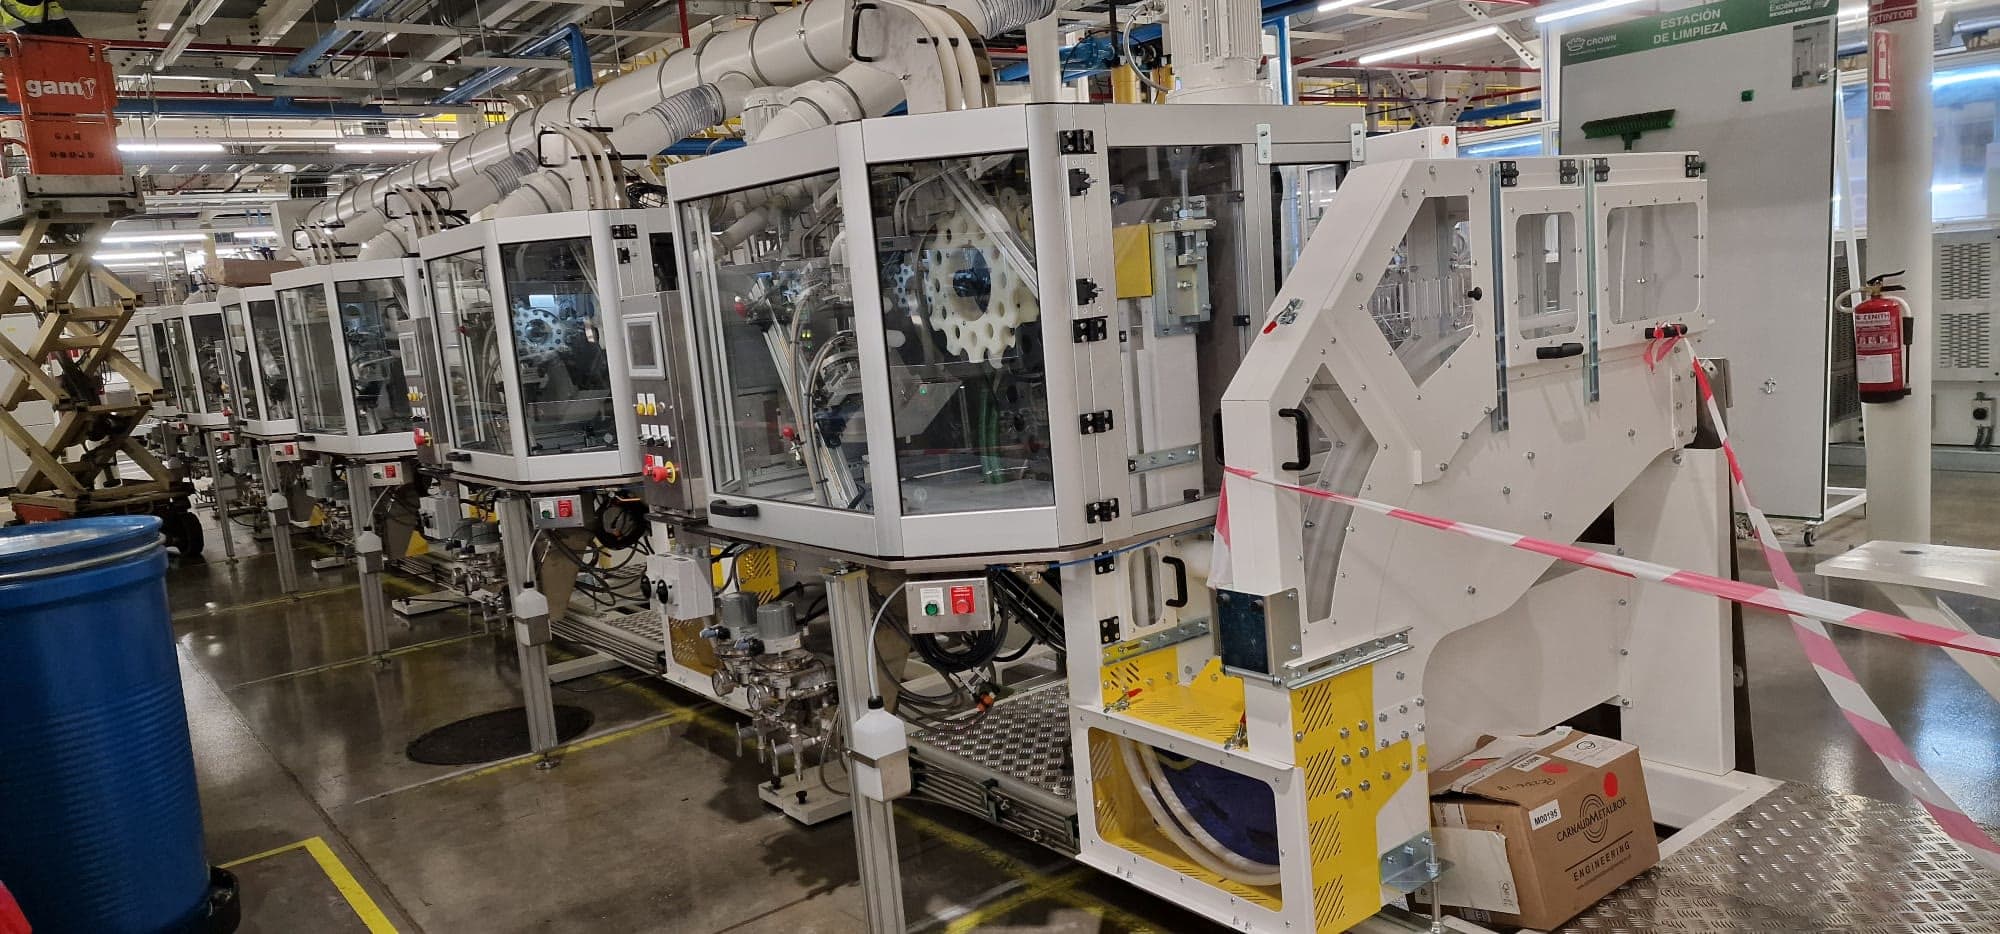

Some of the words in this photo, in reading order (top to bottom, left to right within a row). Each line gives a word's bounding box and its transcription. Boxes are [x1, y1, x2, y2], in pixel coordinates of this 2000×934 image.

[1661, 8, 1721, 29] ESTACIÓN
[1586, 34, 1617, 46] CROWN
[1653, 32, 1670, 45] DE
[1672, 21, 1729, 41] LIMPIEZA
[25, 79, 84, 97] gam
[1534, 808, 1559, 826] M00195
[1573, 841, 1631, 881] ENGINEERING
